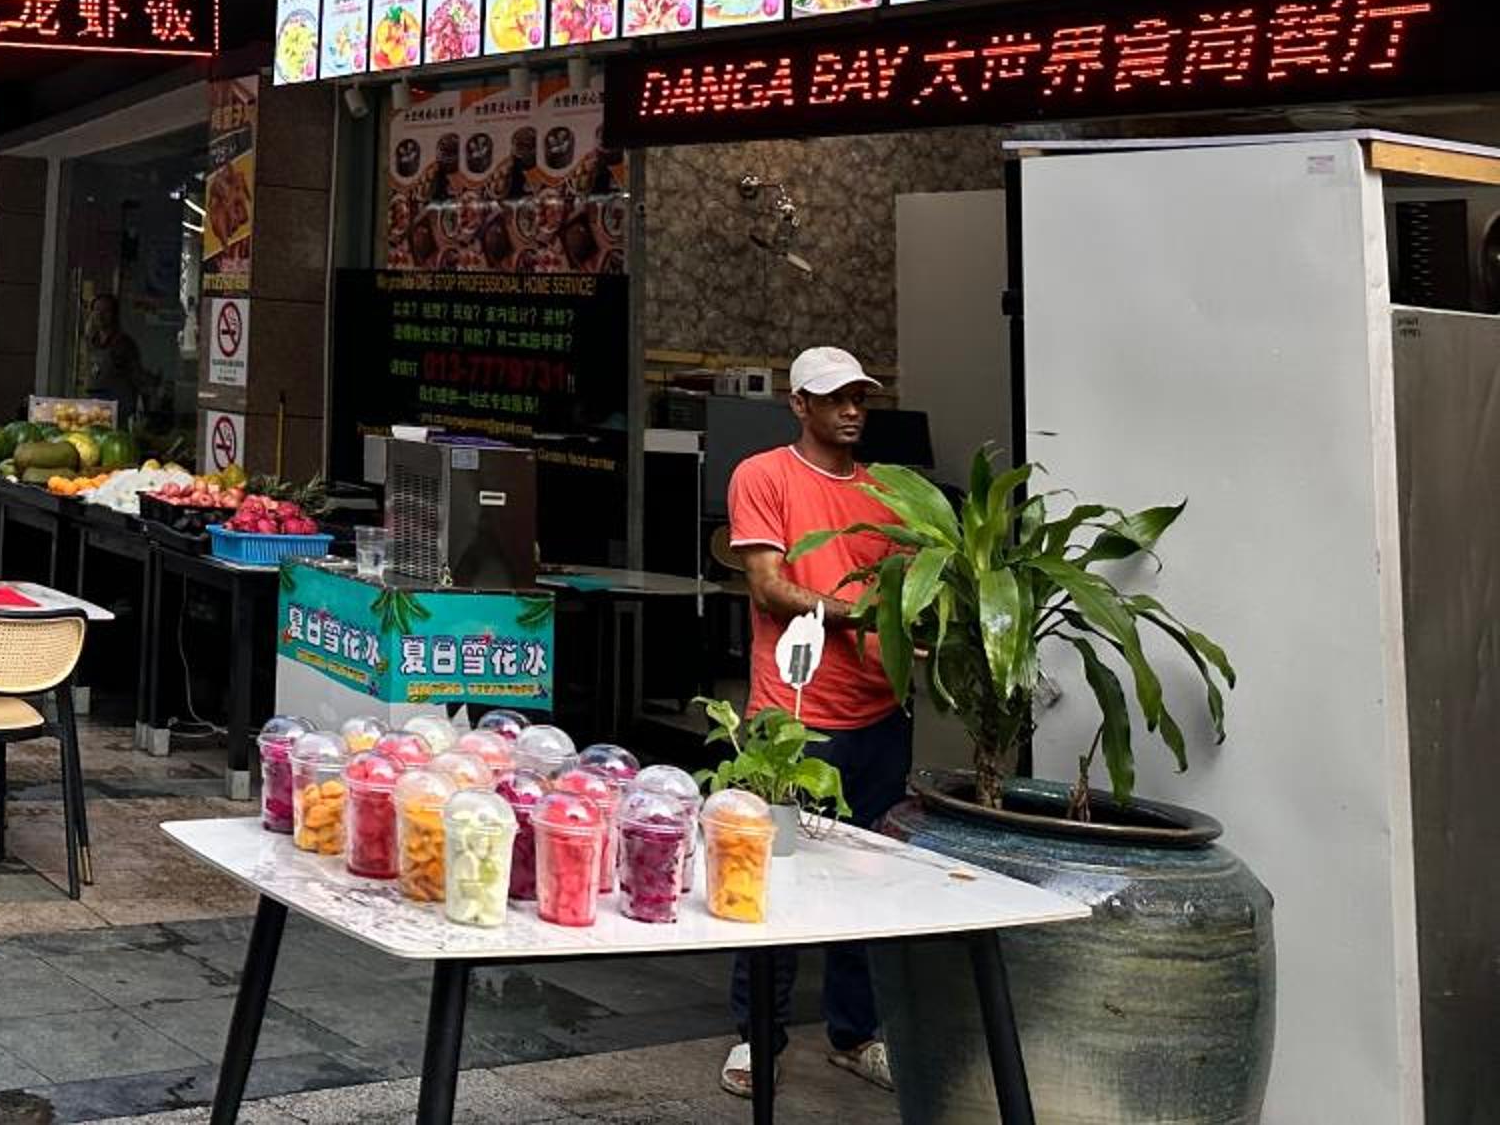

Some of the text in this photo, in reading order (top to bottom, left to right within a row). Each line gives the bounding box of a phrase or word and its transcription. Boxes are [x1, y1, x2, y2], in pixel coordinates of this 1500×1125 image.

[639, 57, 795, 116] DANGA
[808, 44, 910, 106] BAY
[457, 276, 523, 294] PROFESSIONAL
[524, 277, 550, 294] HOME
[287, 602, 380, 668] 夏日雪花冰
[399, 634, 548, 677] 夏日雪花冰
